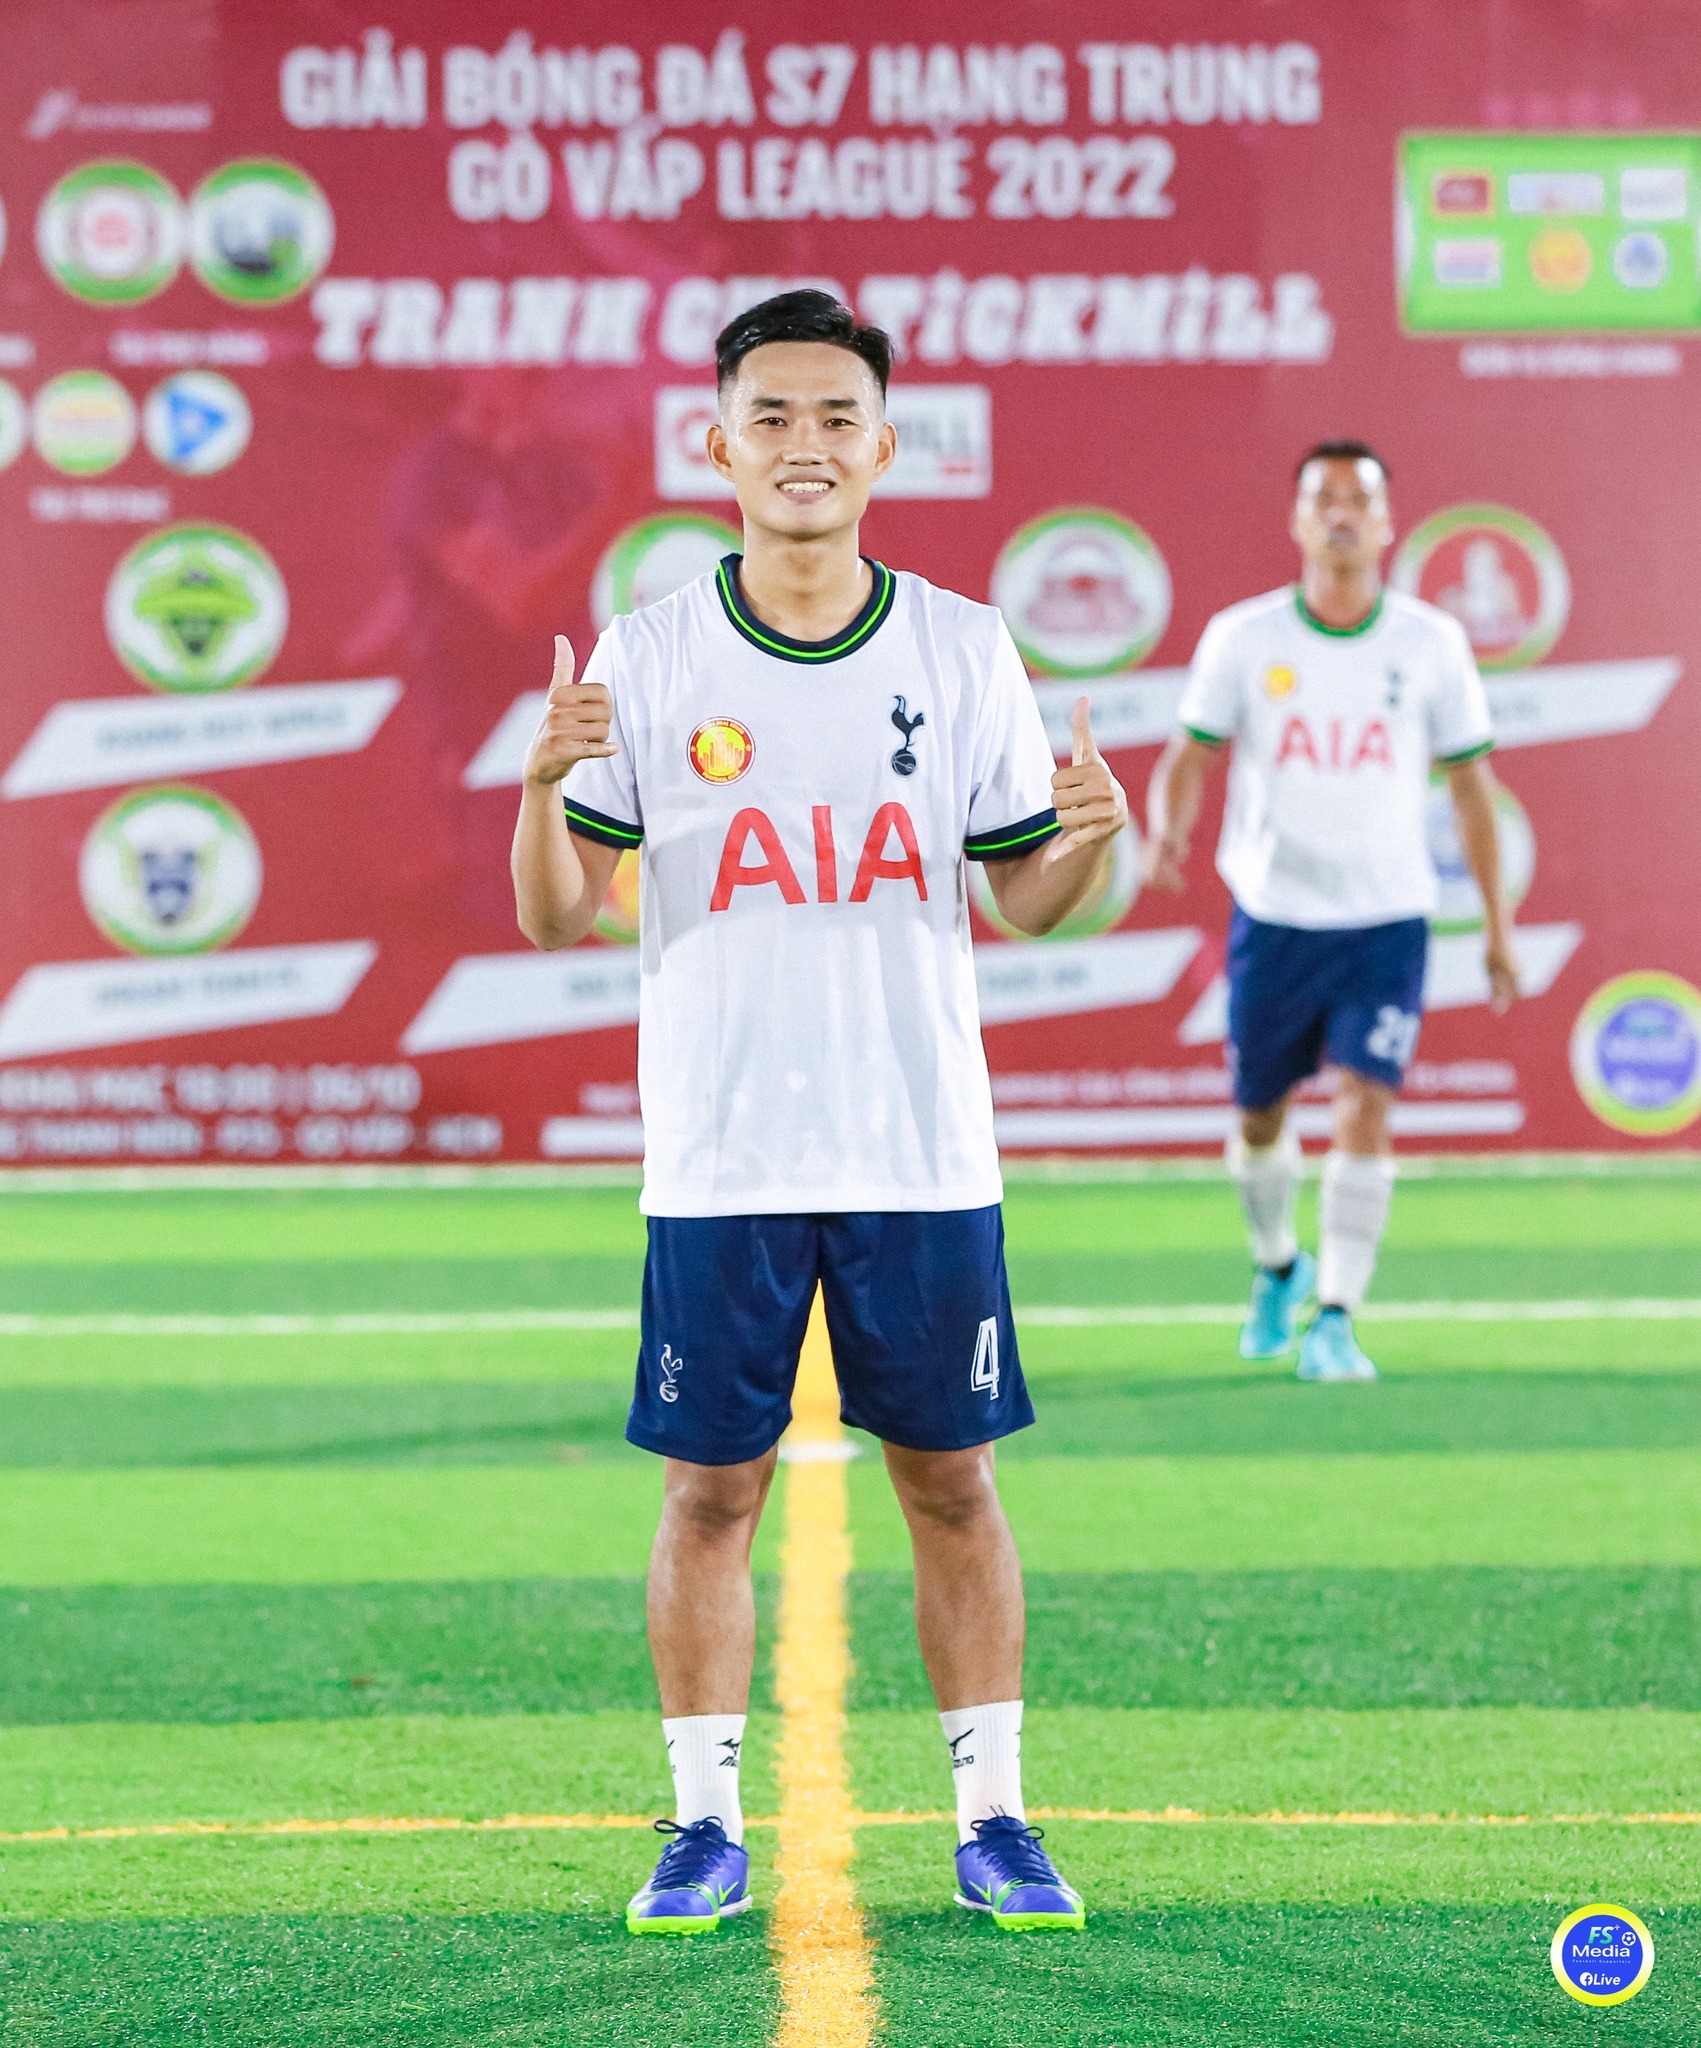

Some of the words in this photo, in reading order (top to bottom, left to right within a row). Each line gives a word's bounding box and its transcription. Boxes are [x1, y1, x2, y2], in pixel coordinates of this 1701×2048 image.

[442, 29, 643, 129] BÓNG
[655, 28, 755, 127] ĐÁ
[766, 43, 856, 126] S7
[1078, 42, 1322, 126] TRUNG
[448, 128, 550, 221] GÒ
[716, 138, 973, 221] LEAGUE
[986, 136, 1175, 220] 2022
[310, 277, 653, 368] TRANH
[1276, 716, 1393, 769] AIA
[710, 802, 928, 912] AIA
[971, 1316, 999, 1400] 4
